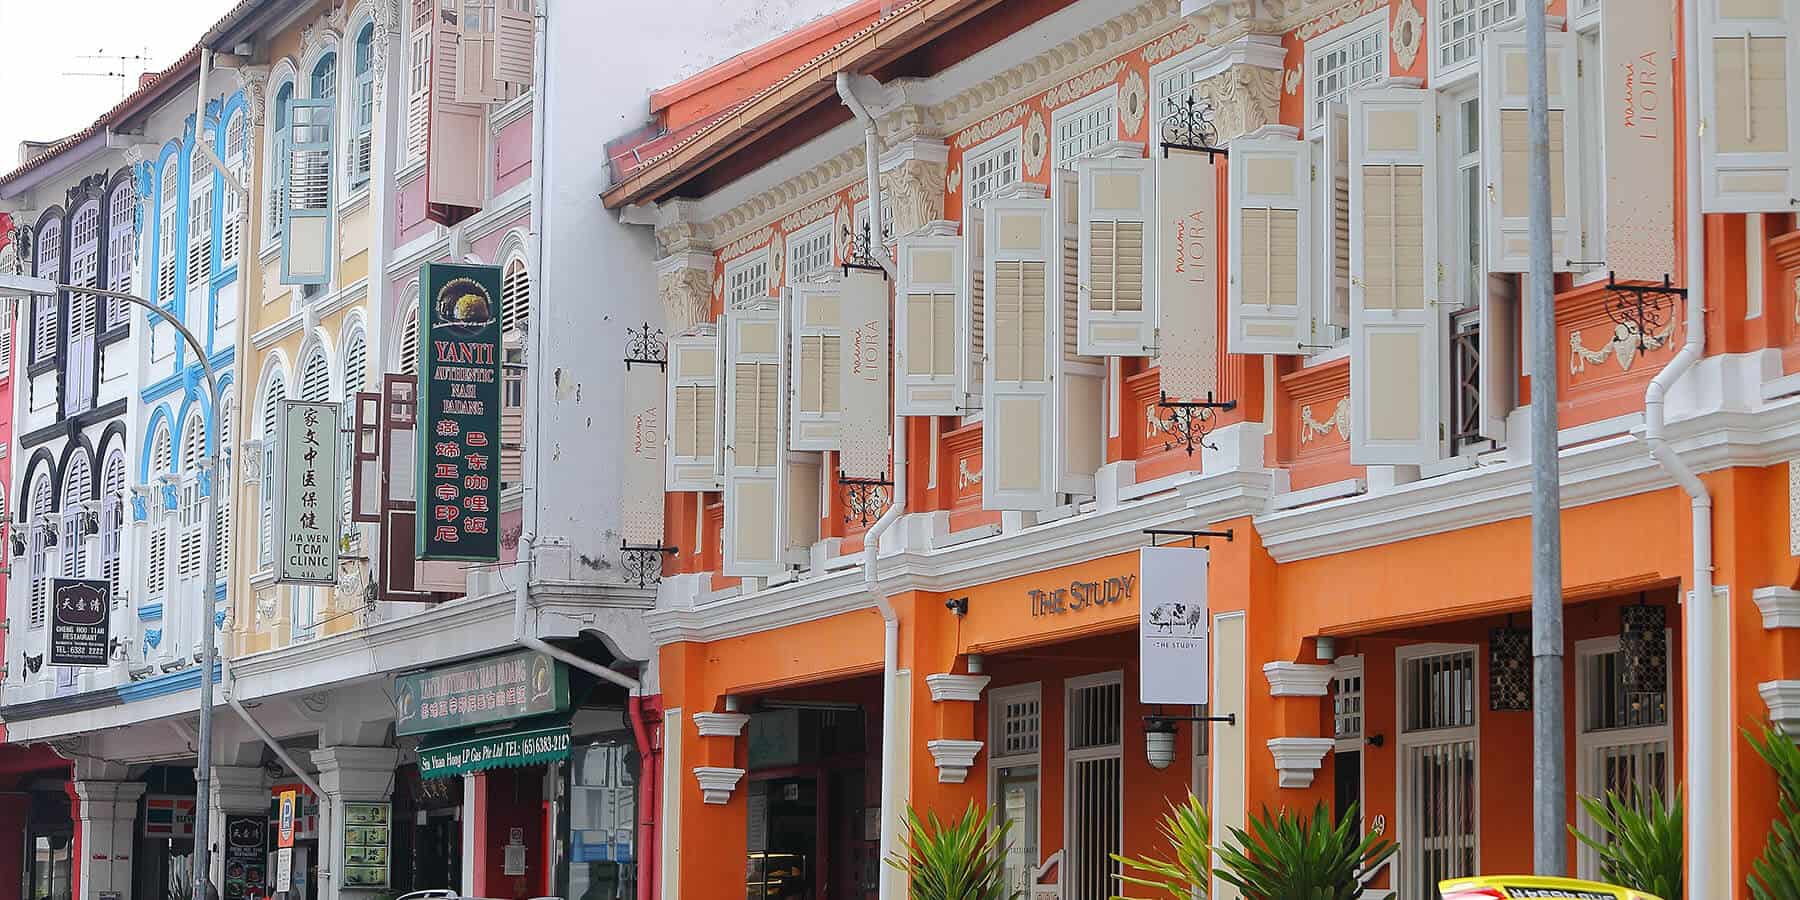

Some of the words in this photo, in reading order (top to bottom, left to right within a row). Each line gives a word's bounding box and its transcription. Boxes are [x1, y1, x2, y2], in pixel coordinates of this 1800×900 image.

[1639, 51, 1657, 139] LIORA
[1189, 210, 1205, 282] LIORA
[434, 340, 494, 365] YANTI
[864, 320, 879, 382] LIORA
[644, 407, 657, 460] LIORA
[299, 407, 320, 530] 家文中医保健
[289, 533, 303, 542] JIA
[306, 534, 329, 543] WEN
[290, 555, 329, 567] CLINIC
[295, 543, 321, 554] TCM
[1027, 587, 1067, 617] THE
[1069, 573, 1136, 610] STUDY
